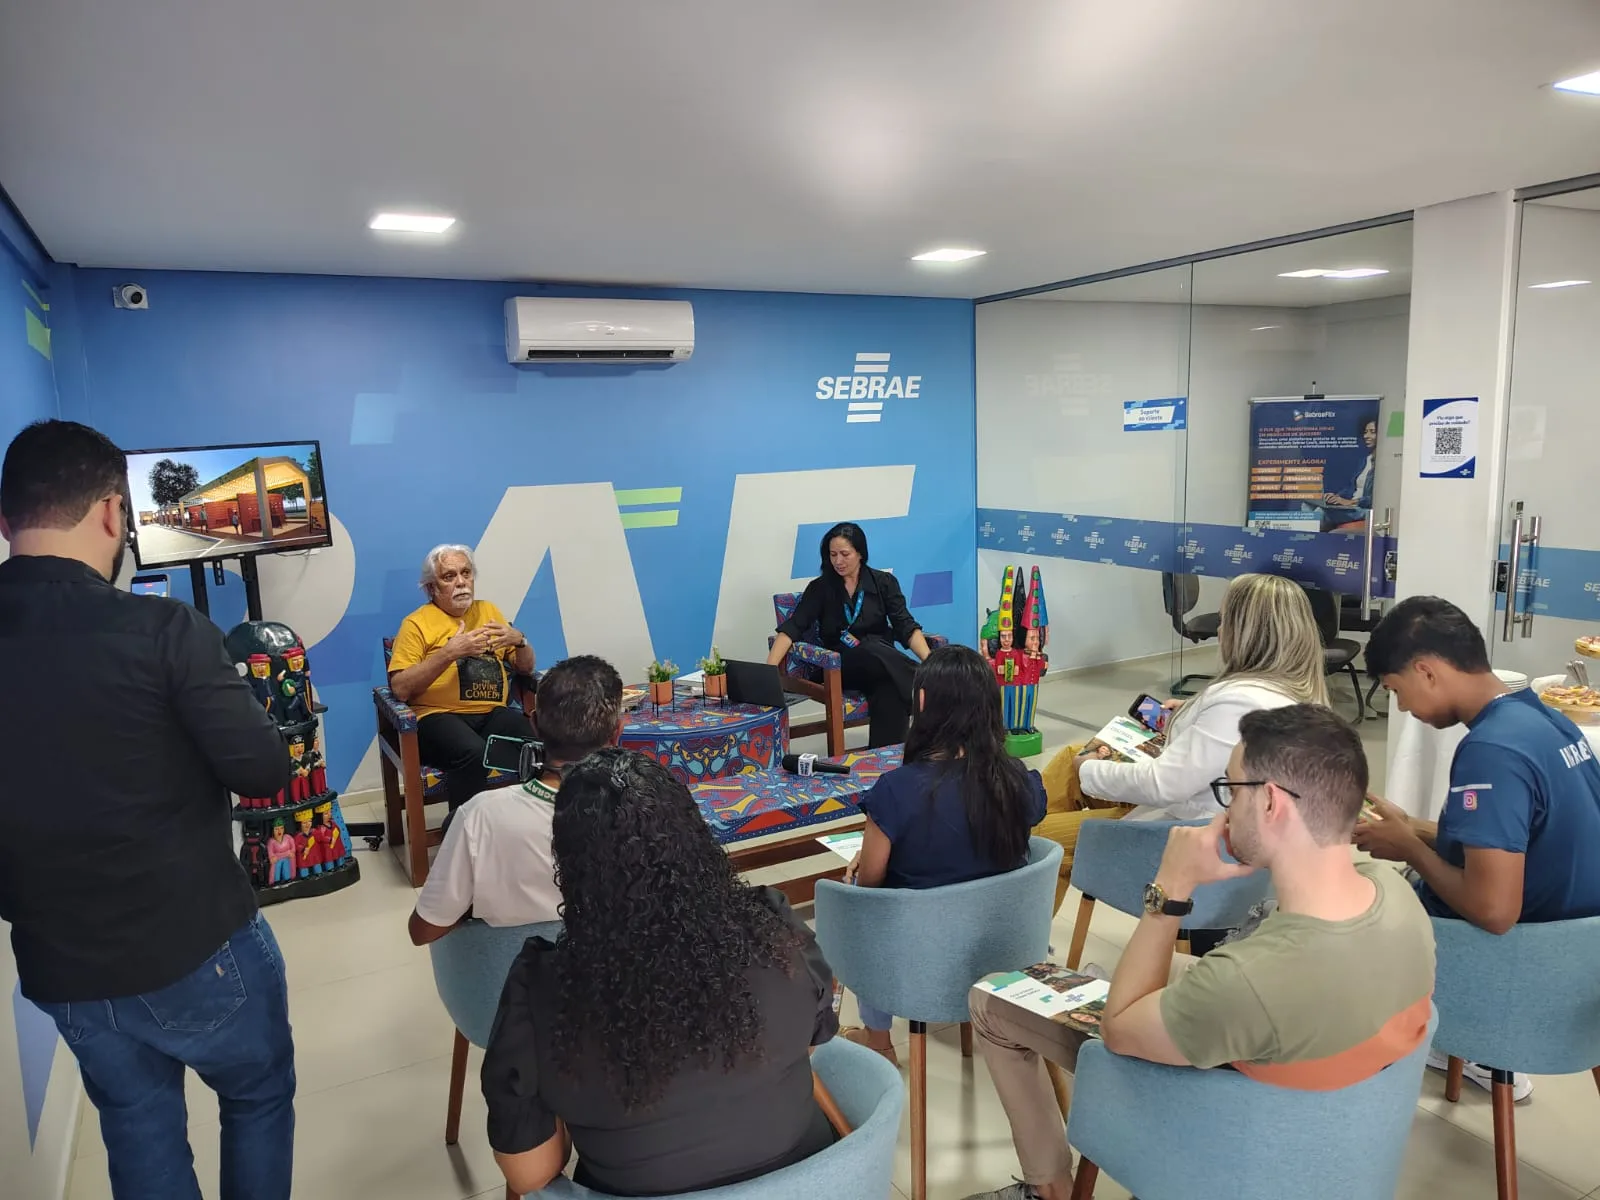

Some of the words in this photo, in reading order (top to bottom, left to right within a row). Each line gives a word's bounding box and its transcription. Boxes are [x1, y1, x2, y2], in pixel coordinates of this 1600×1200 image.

[816, 375, 922, 400] SEBRAE
[1083, 536, 1105, 546] SEBRAE
[1124, 539, 1148, 550] SEBRAE
[1177, 544, 1206, 554] SEBRAE
[1224, 549, 1254, 559] SEBRAE
[1272, 553, 1304, 564] SEBRAE
[1326, 558, 1360, 570] SEBRAE
[472, 682, 499, 692] DIVINE
[465, 689, 500, 699] COMEDY
